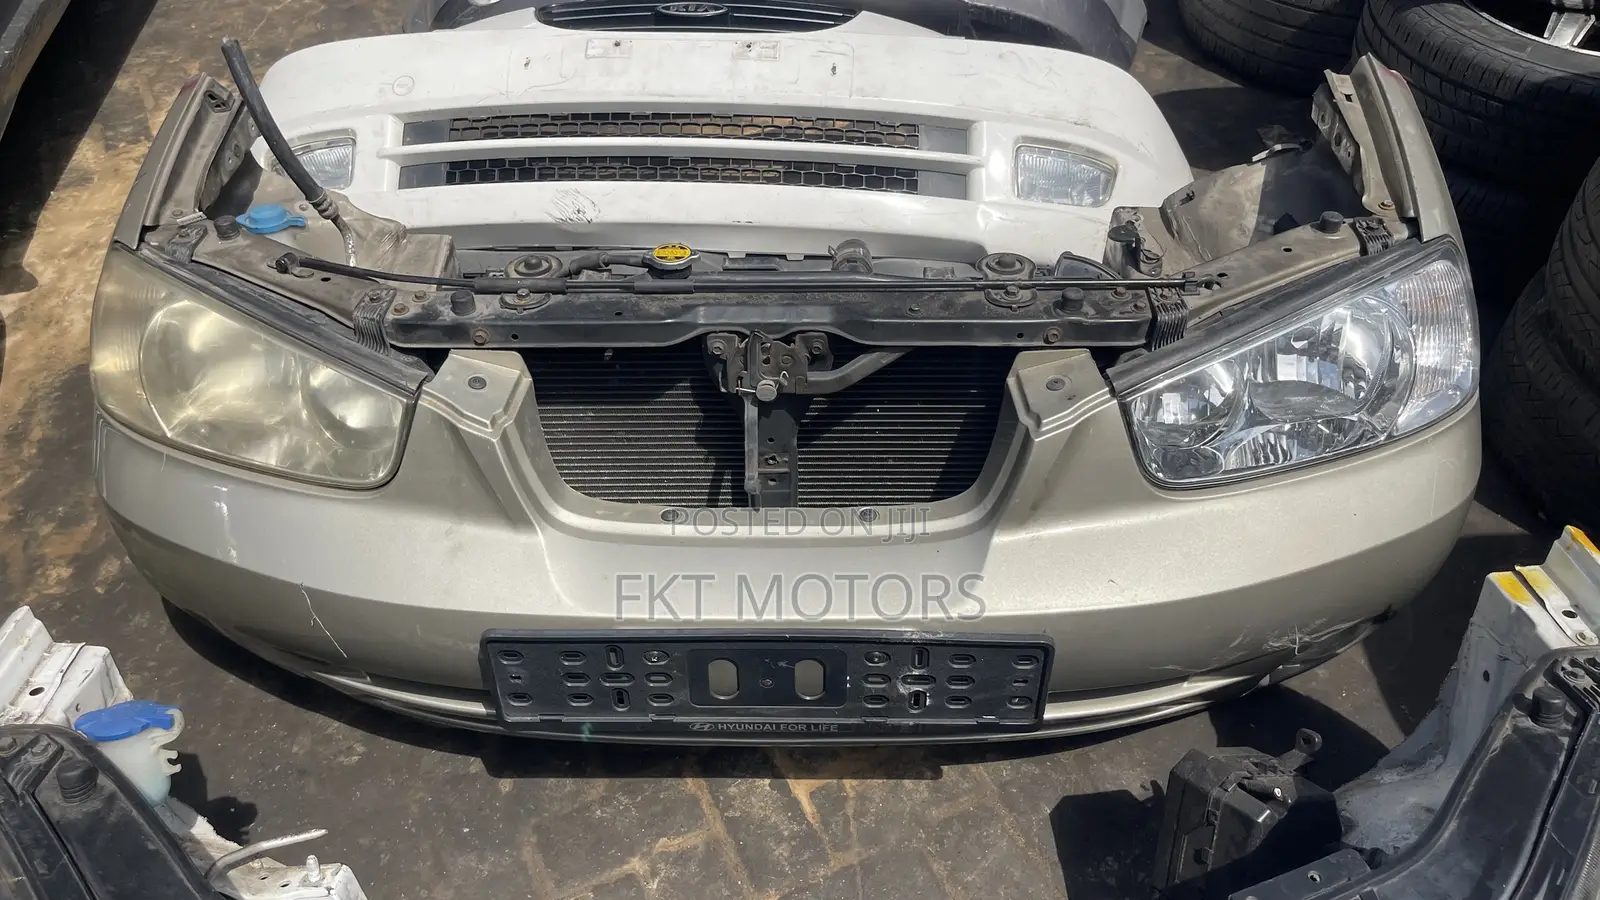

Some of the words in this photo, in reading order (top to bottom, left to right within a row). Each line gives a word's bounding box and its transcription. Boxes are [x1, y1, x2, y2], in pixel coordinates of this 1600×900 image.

[718, 723, 776, 731] HYUNDAI
[780, 723, 807, 731] FOR
[811, 724, 839, 732] LIFE
